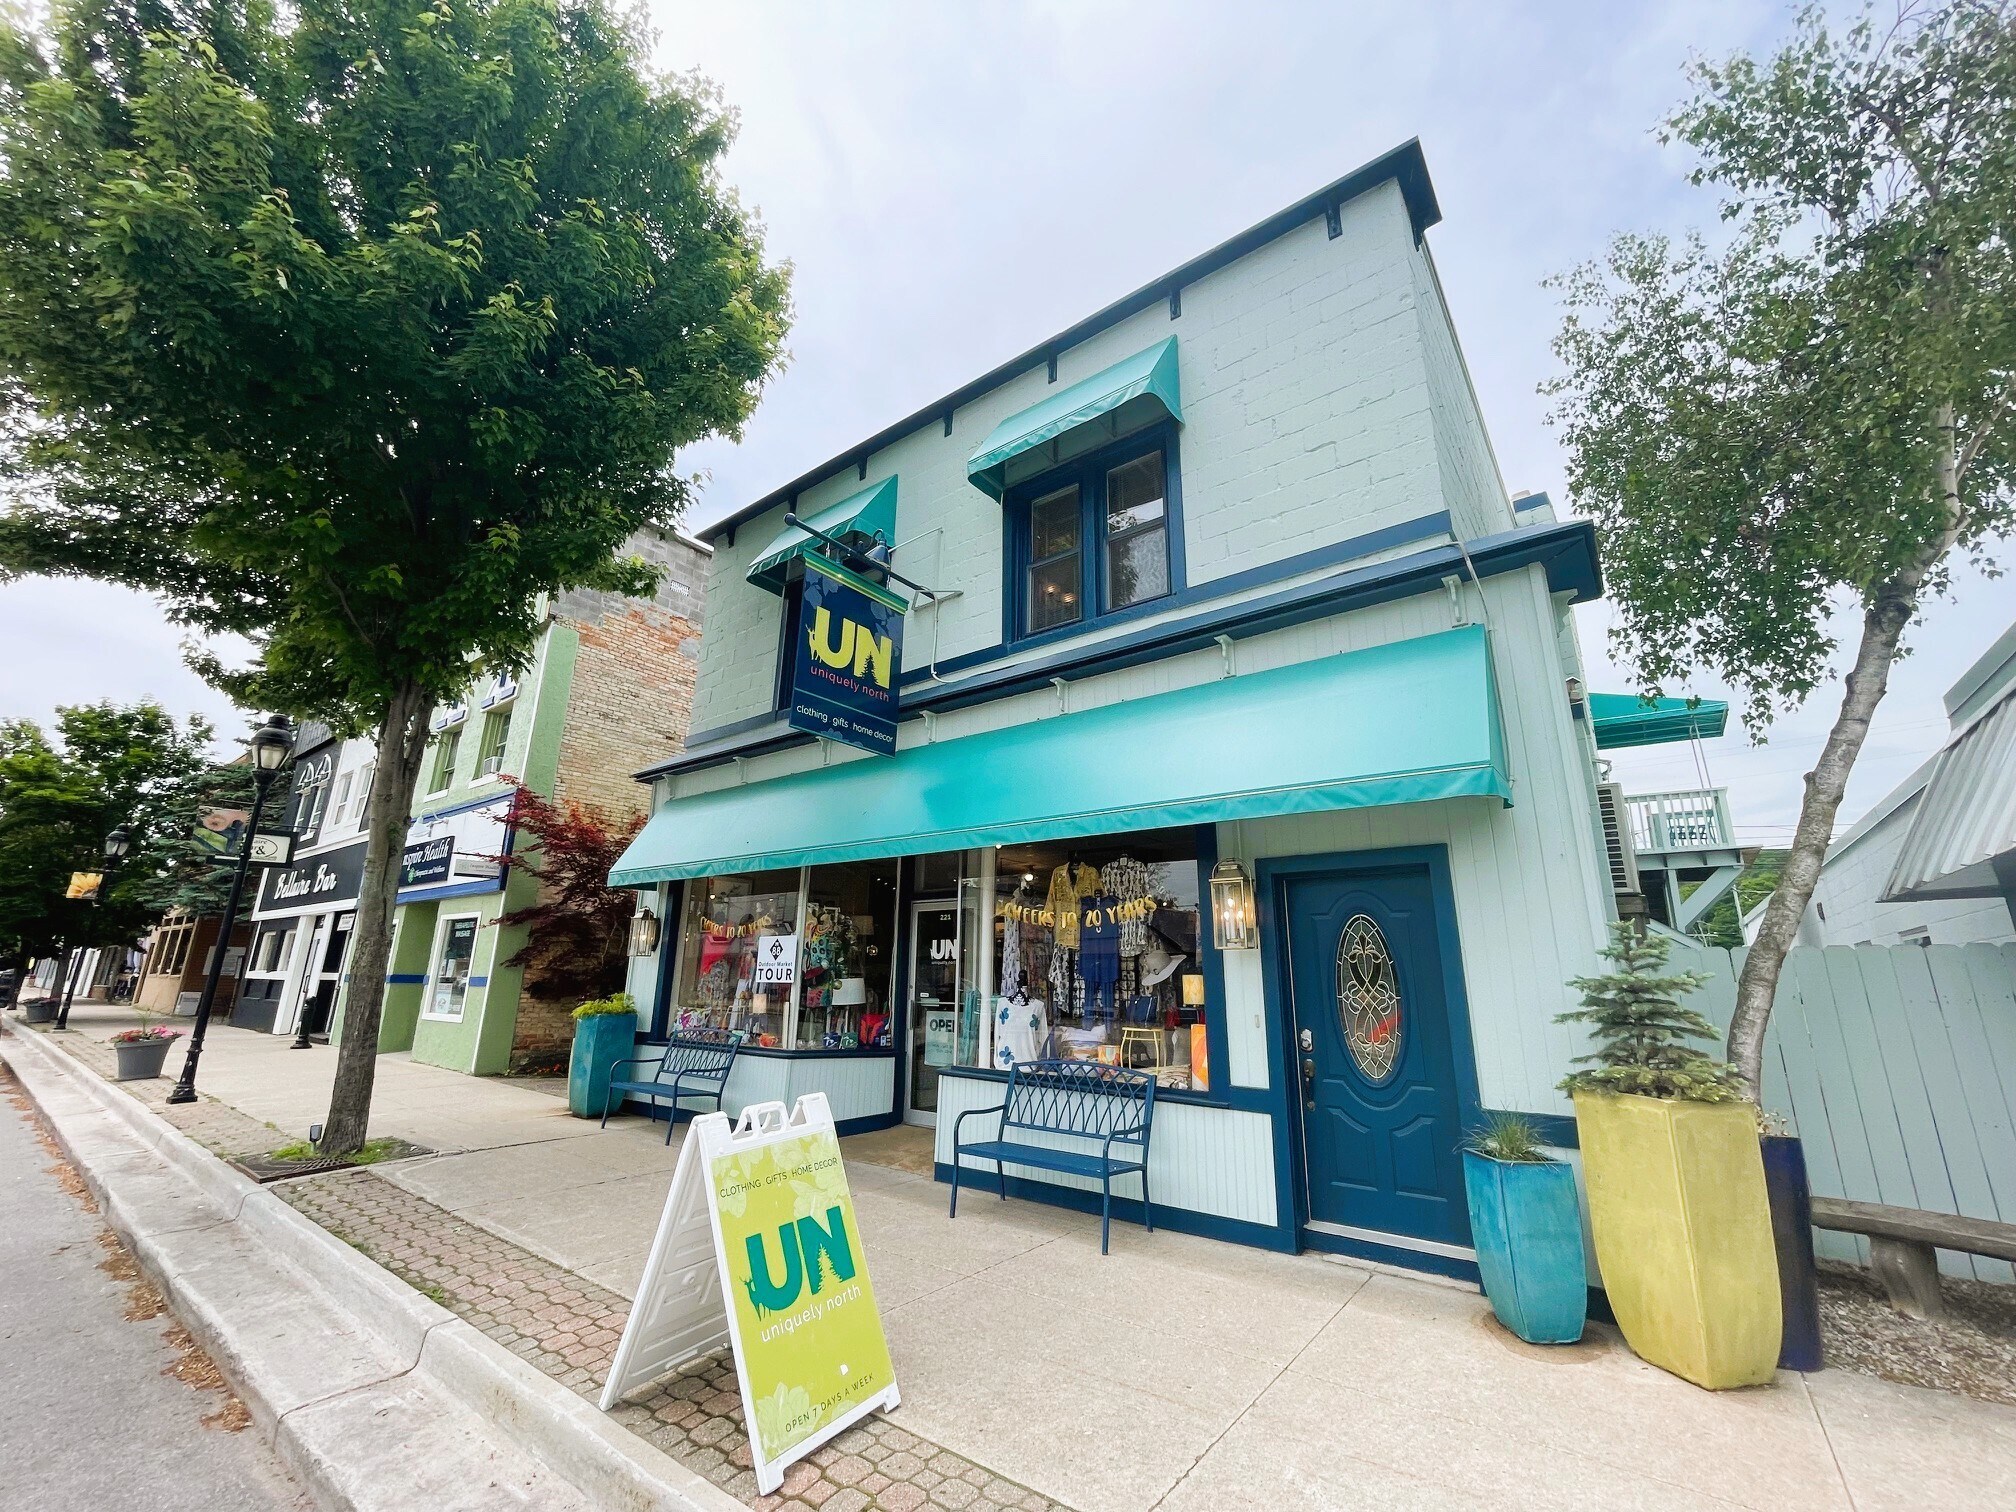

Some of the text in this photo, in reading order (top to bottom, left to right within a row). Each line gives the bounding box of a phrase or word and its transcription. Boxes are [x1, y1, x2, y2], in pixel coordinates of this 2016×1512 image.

[812, 606, 893, 689] UN
[811, 665, 889, 702] uniquely north
[796, 704, 893, 743] clothing gifts home decor
[422, 838, 450, 862] Health
[274, 863, 337, 900] Bellaire Bar
[1086, 909, 1102, 927] 20
[772, 946, 781, 956] 88
[758, 968, 792, 980] TOUR
[720, 1157, 838, 1198] CLOTHING GIFTS HOME DECOR
[745, 1205, 856, 1311] UN
[761, 1284, 861, 1342] uniquely north
[785, 1372, 874, 1432] OPEN 7 DAYS A WEEK
